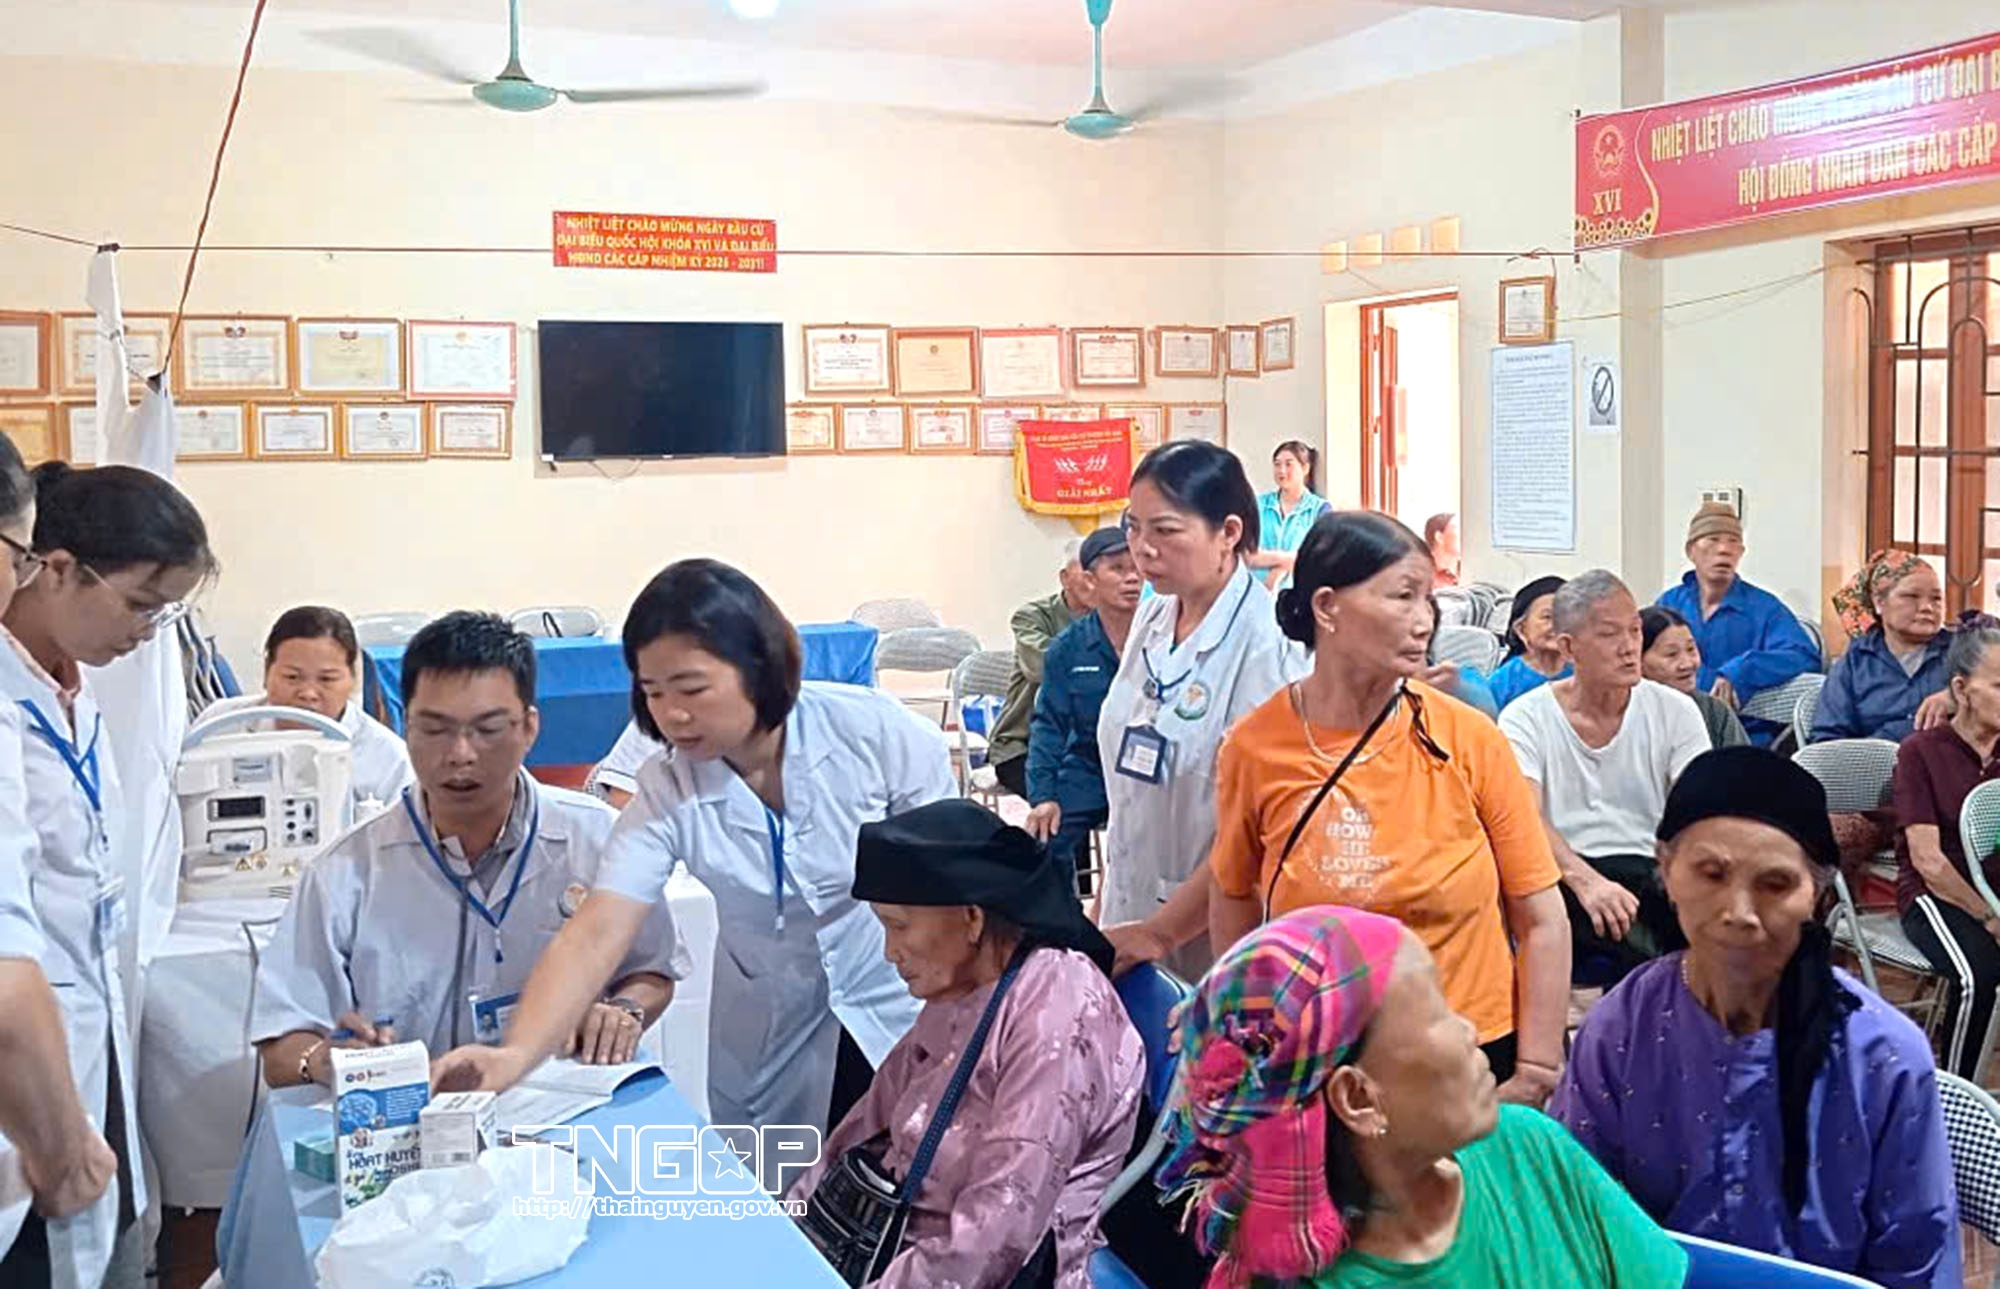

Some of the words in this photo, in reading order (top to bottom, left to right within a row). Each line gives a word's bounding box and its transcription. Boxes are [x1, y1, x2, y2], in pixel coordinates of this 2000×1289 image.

[1652, 115, 1690, 165] NHIỆT
[1695, 108, 1723, 158] LIỆT
[1951, 50, 1985, 105] ĐẠI
[1592, 188, 1622, 216] XVI
[1739, 160, 1764, 212] HỘI
[1913, 124, 1952, 176] CÁC
[1957, 109, 1998, 168] CẤP
